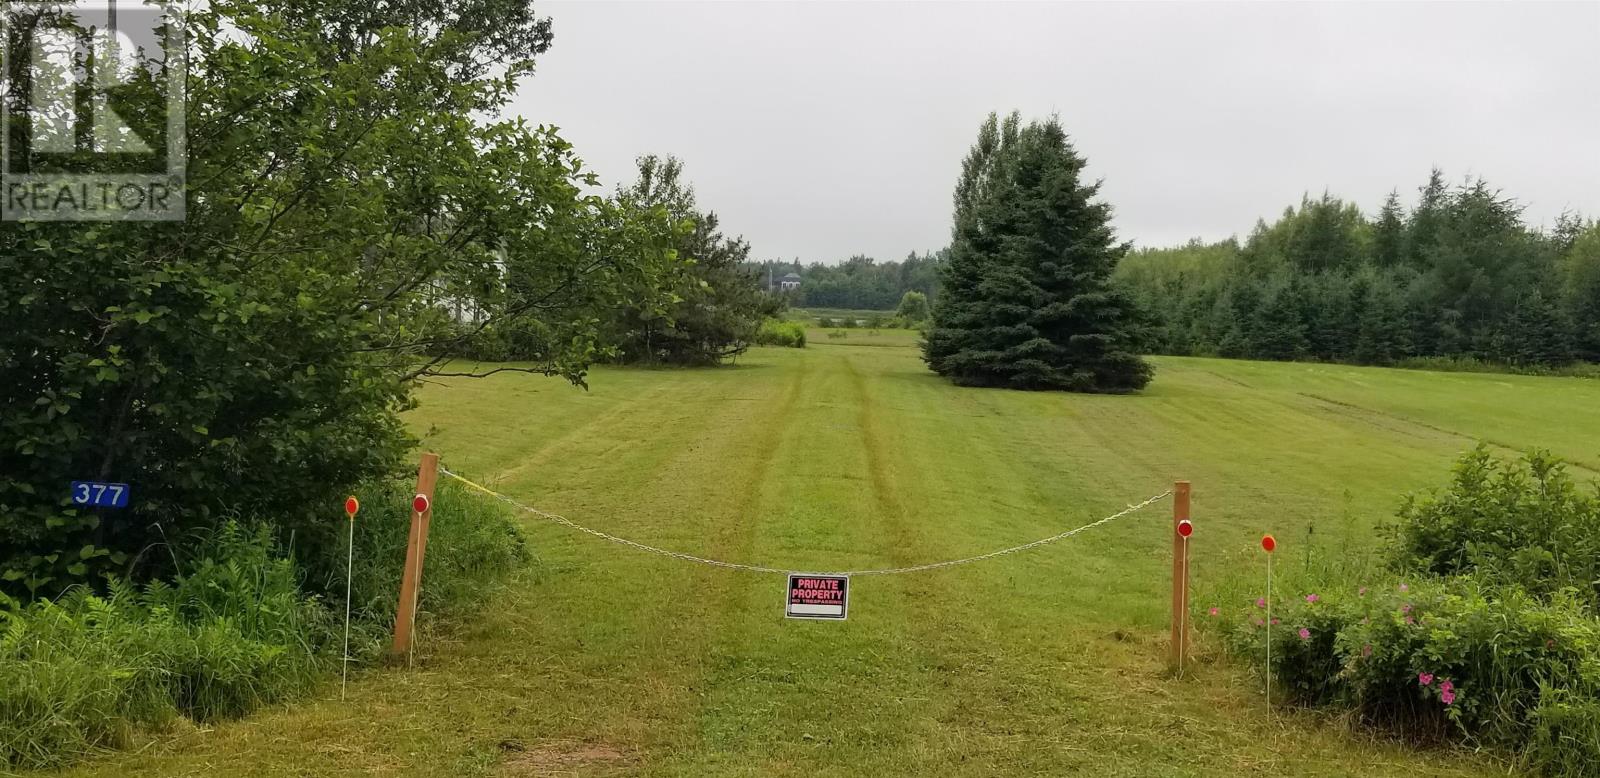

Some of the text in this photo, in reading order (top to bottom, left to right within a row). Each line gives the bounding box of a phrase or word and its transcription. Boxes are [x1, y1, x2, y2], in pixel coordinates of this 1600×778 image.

[75, 483, 124, 505] 377
[798, 579, 838, 589] PRIVATE
[792, 589, 843, 599] PROPERTY
